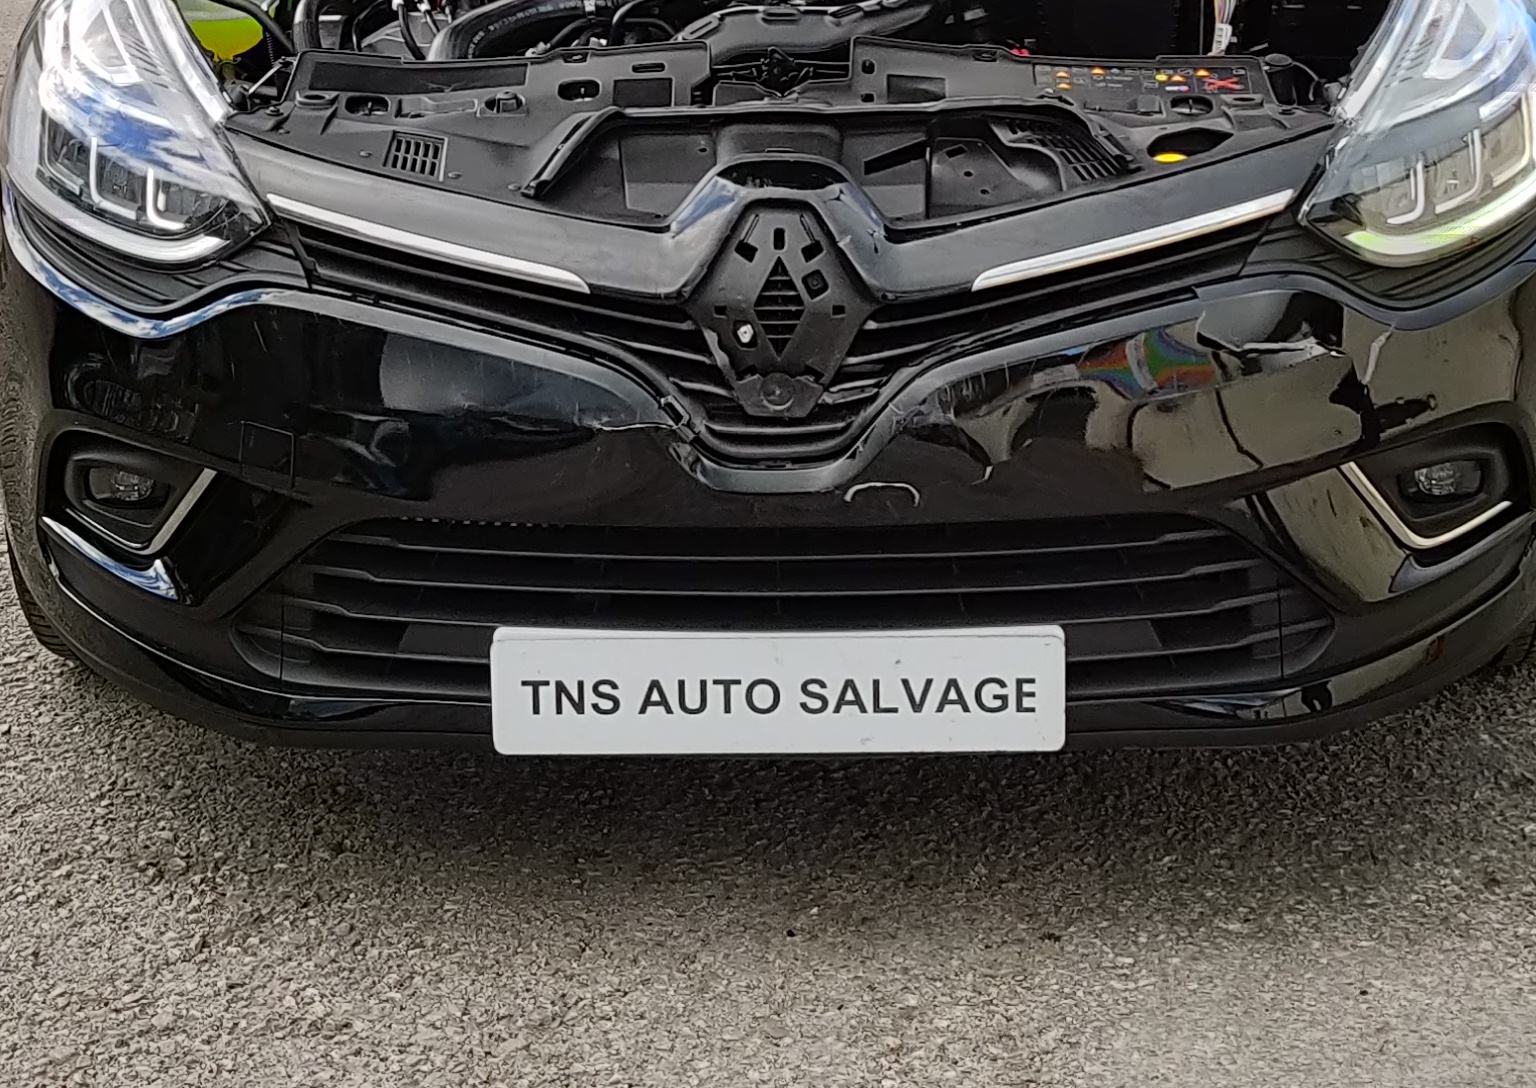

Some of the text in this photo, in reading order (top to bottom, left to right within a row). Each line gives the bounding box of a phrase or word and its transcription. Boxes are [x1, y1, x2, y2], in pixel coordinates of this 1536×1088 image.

[521, 677, 1036, 715] TNS AUTO SALVAGE
